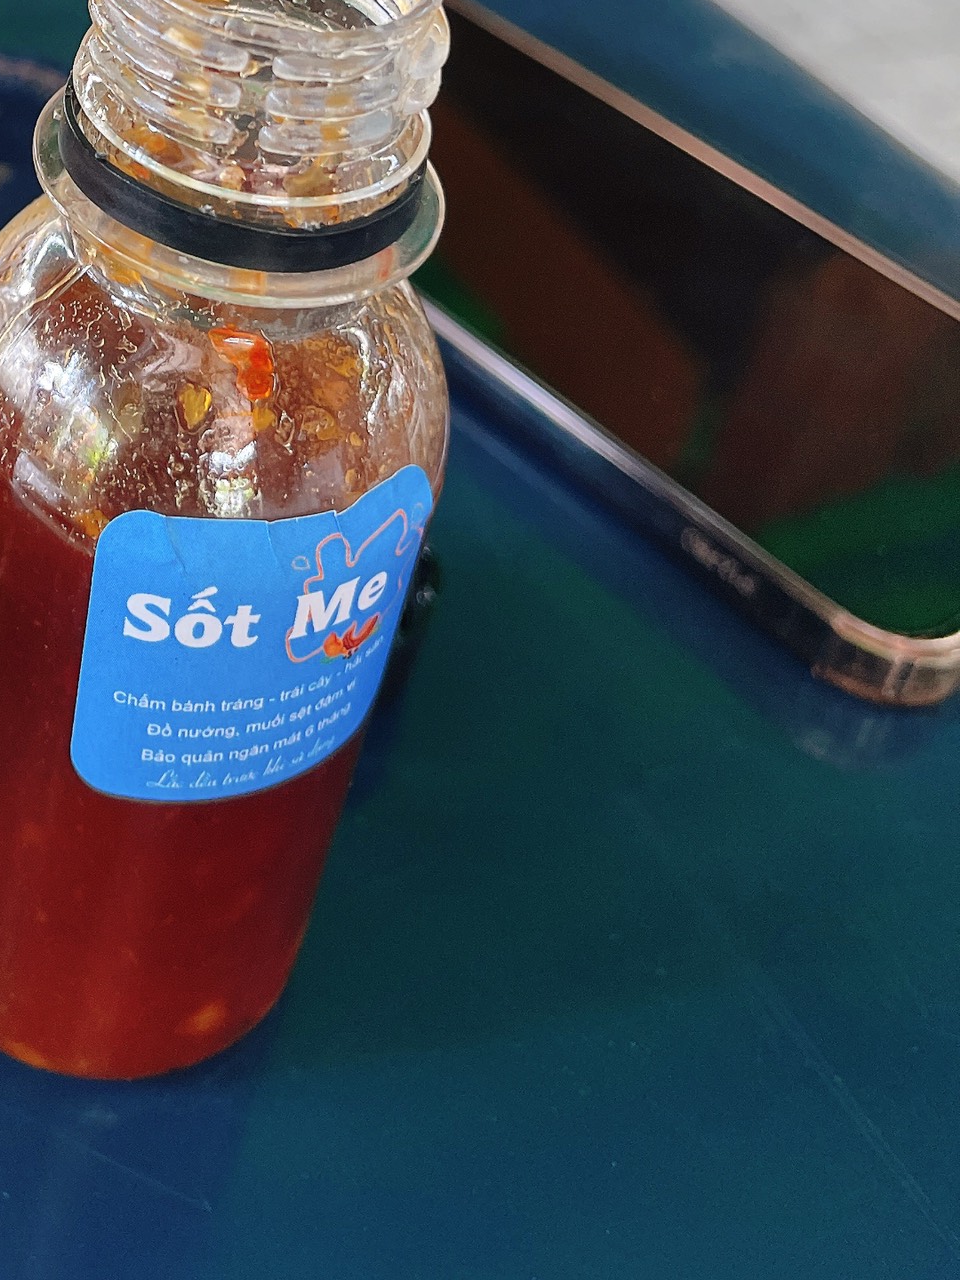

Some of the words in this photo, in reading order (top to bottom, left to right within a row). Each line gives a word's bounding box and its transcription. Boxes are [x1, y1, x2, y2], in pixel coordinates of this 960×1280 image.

[123, 586, 262, 648] Sốt
[288, 571, 388, 640] Me
[113, 690, 166, 711] Chấm
[171, 699, 216, 713] bánh
[221, 697, 264, 712] tráng
[280, 683, 304, 702] trái
[308, 673, 332, 692] cây
[141, 748, 175, 763] Bảo
[181, 750, 223, 766] quản
[273, 731, 301, 750] mát
[305, 724, 314, 737] 6
[317, 702, 351, 731] tháng
